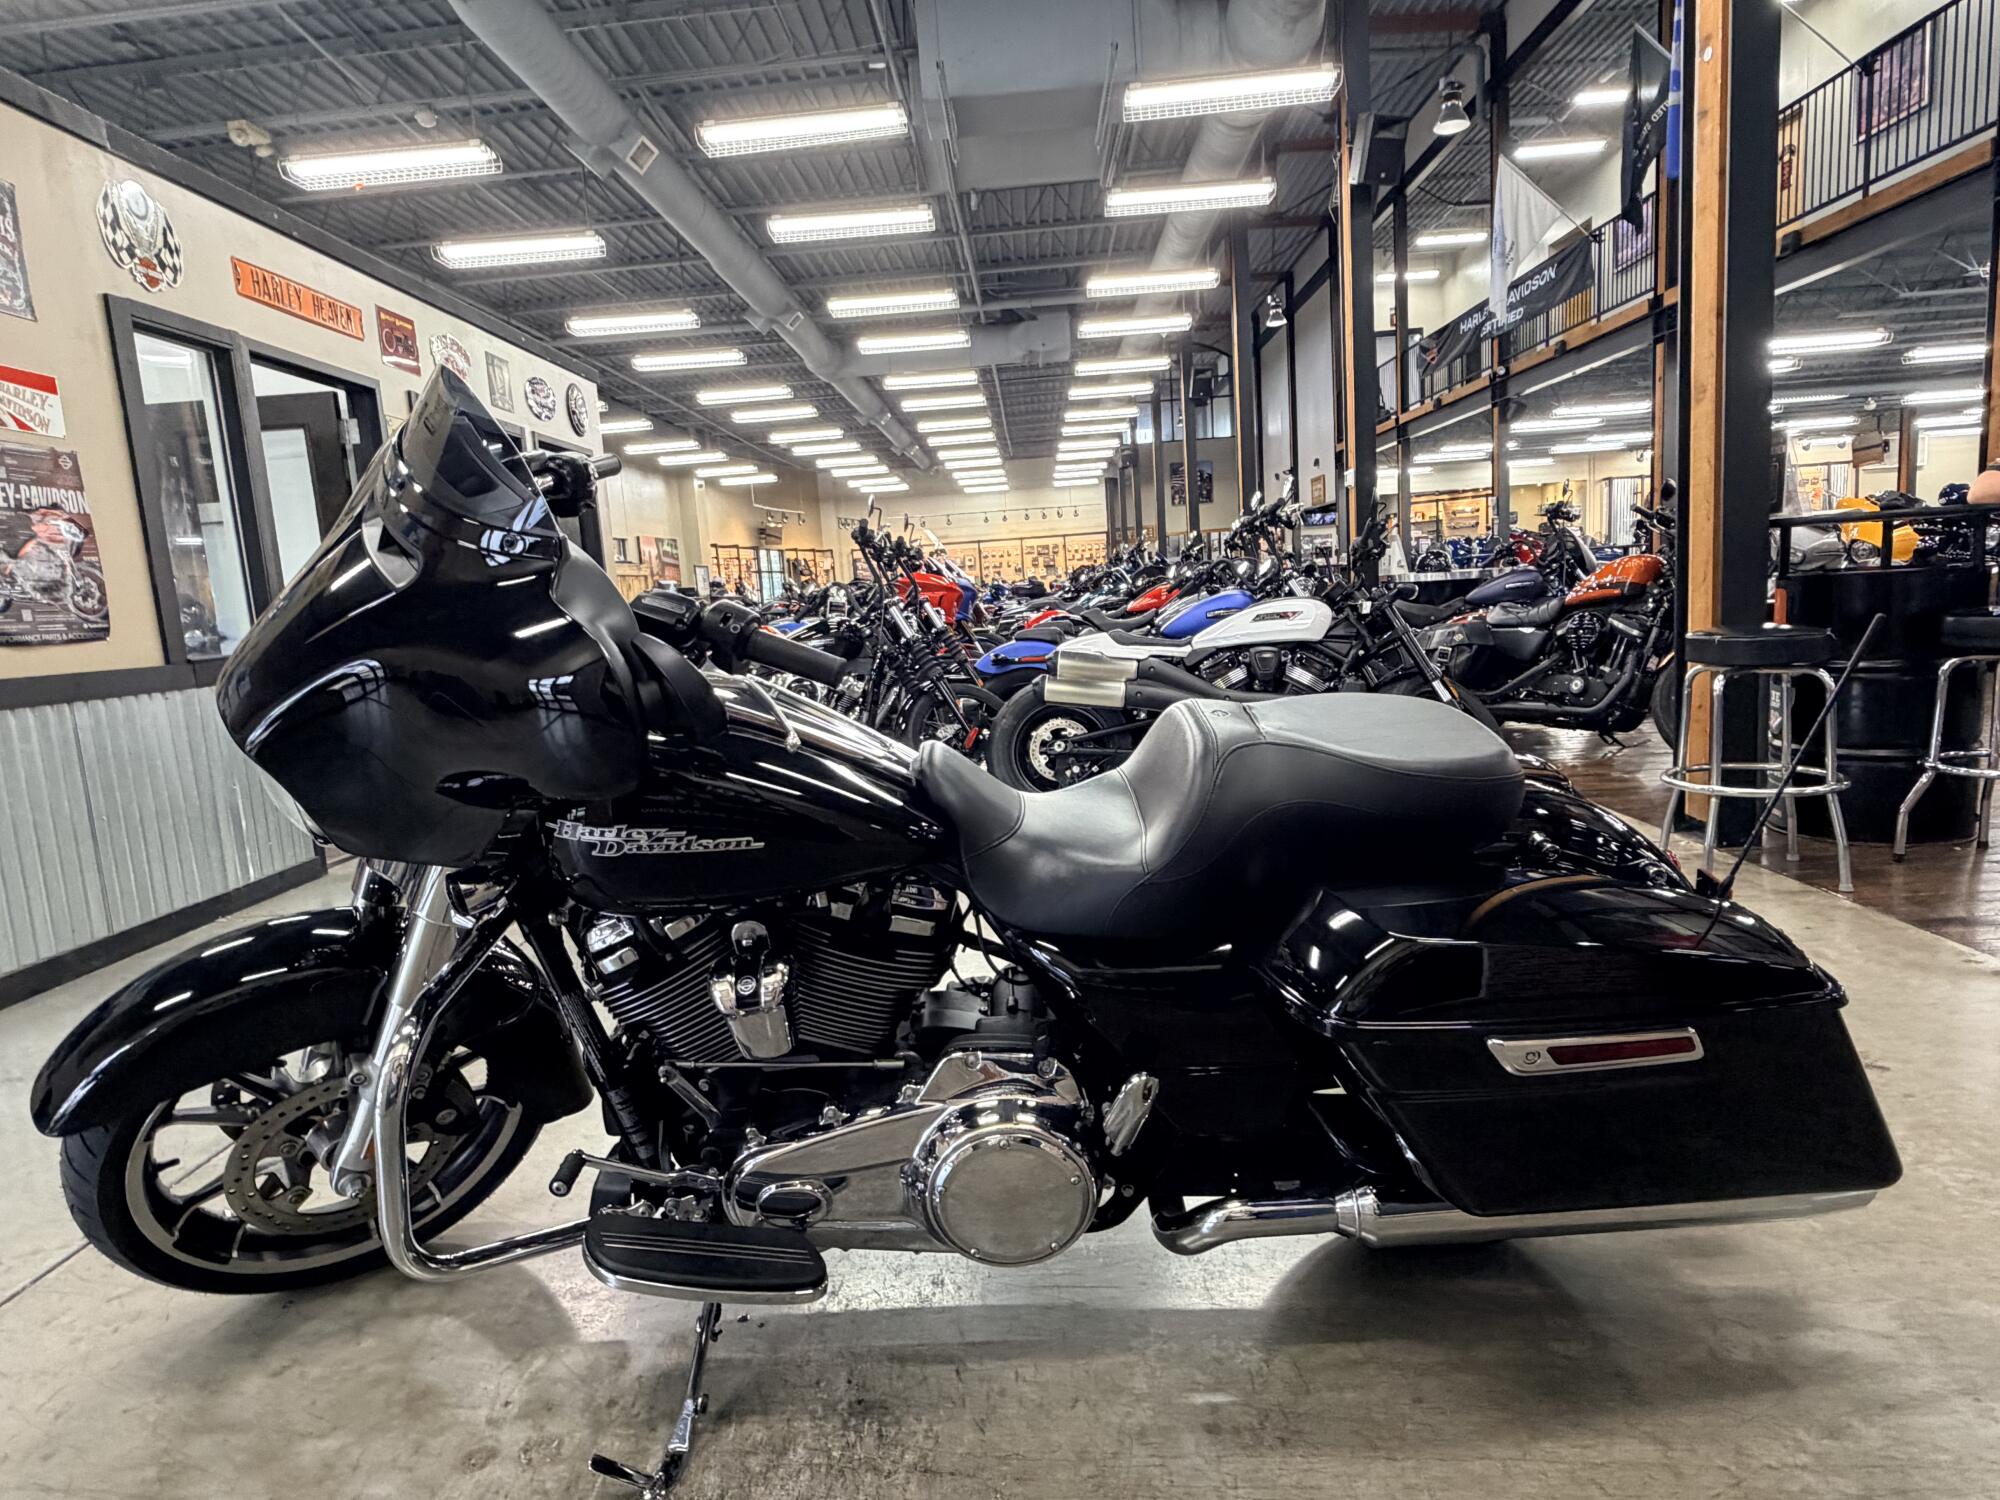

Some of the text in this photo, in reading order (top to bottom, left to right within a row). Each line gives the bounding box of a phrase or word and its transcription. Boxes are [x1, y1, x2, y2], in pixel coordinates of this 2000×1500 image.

[250, 267, 303, 312] HARLEY
[311, 293, 356, 333] HEAVEN
[591, 835, 765, 857] Davidson
